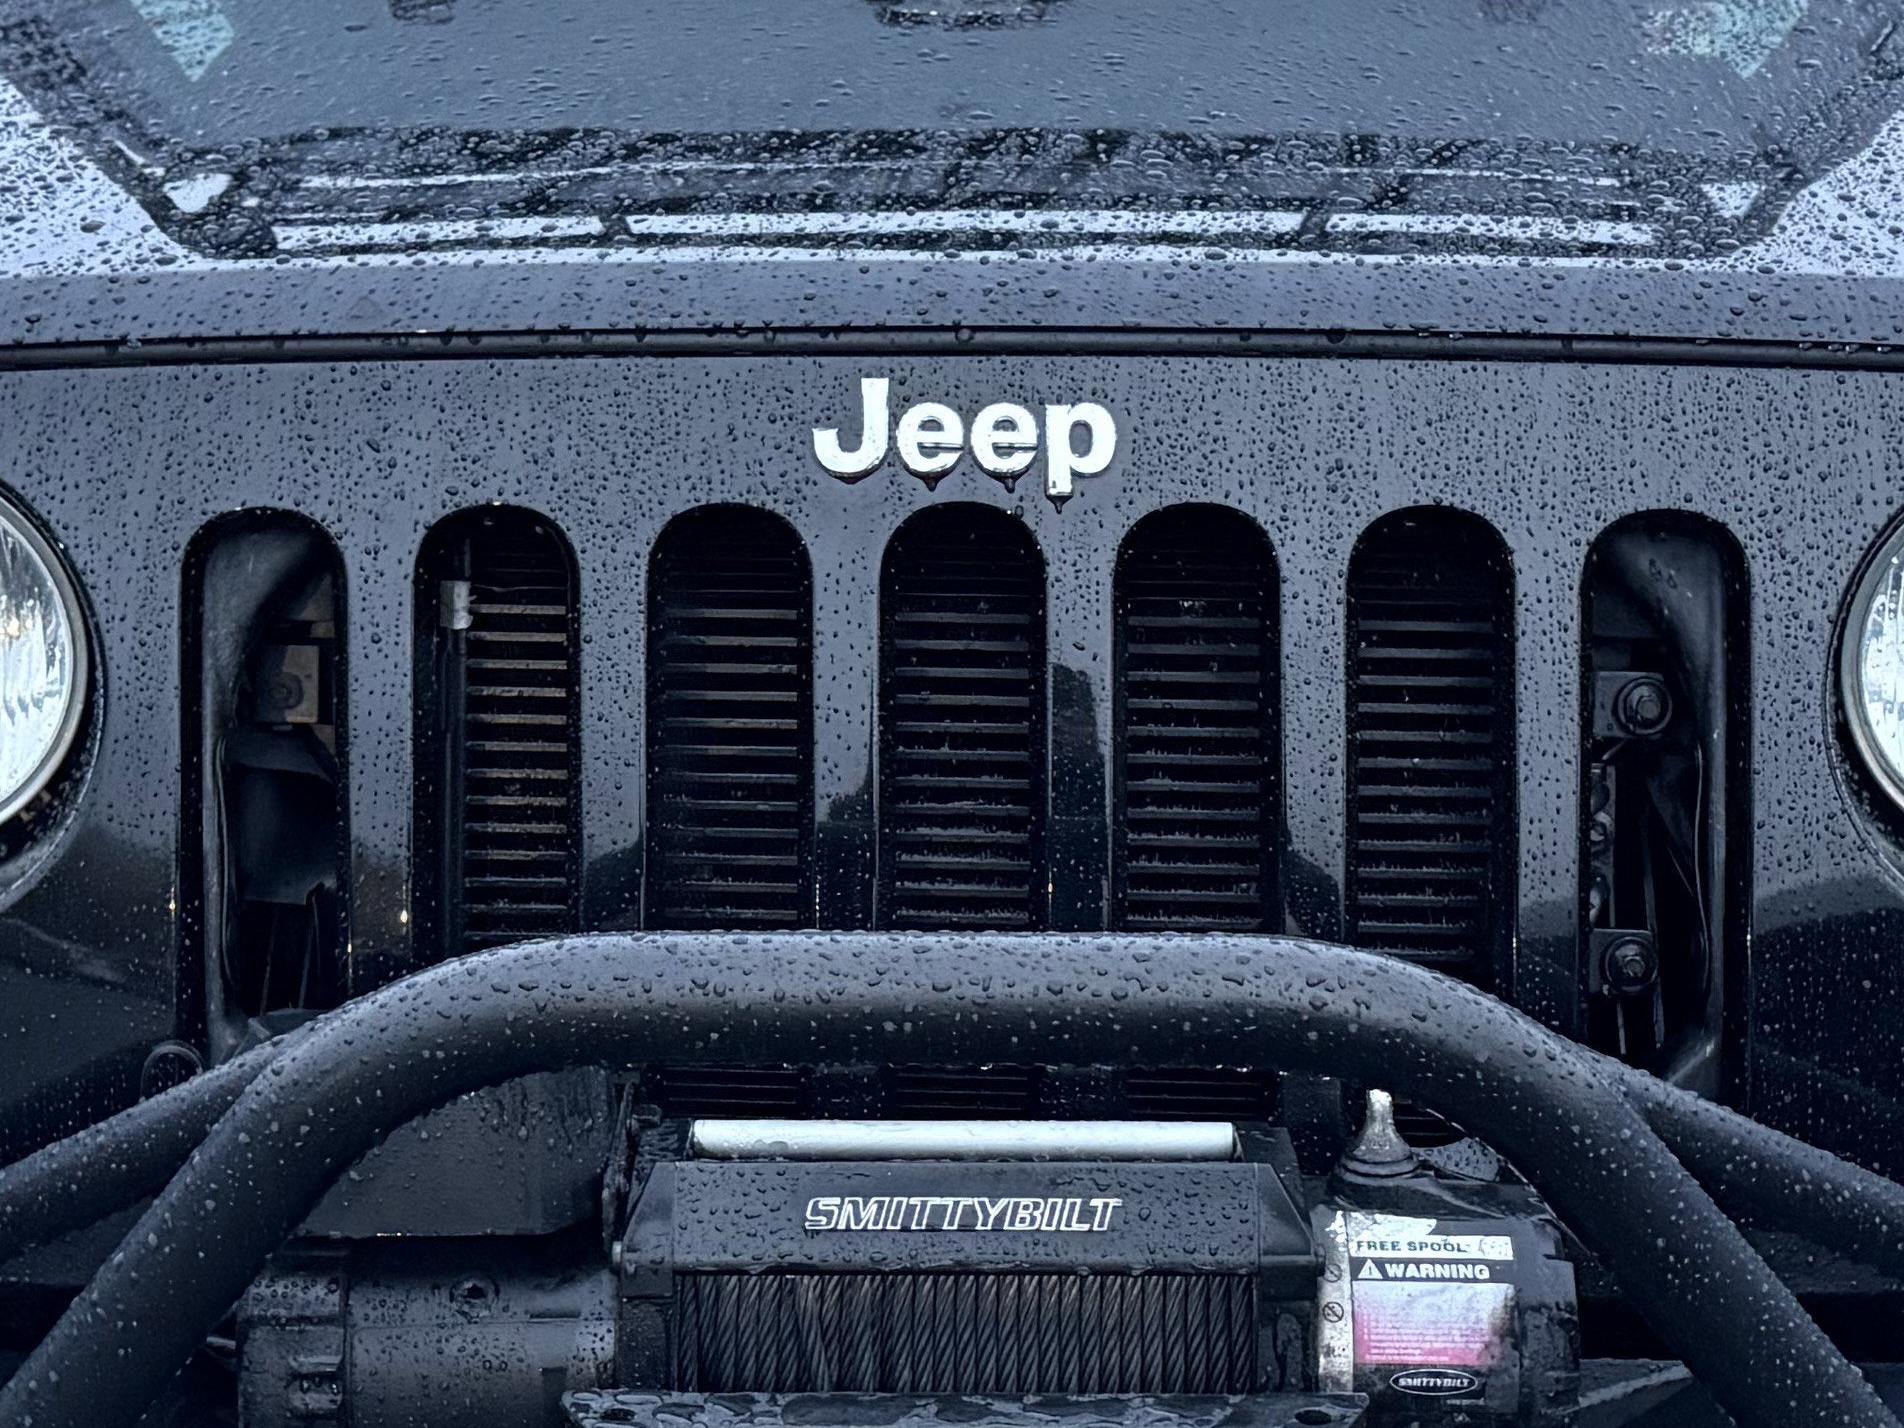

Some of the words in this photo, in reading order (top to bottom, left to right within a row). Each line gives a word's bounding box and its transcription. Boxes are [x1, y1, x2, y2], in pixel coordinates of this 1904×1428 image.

[812, 377, 1117, 497] Jeep
[805, 1197, 1122, 1231] SMITTYBILT
[1357, 1240, 1401, 1252] FREE
[1407, 1241, 1468, 1253] SPOOL
[1384, 1264, 1490, 1280] WARNING
